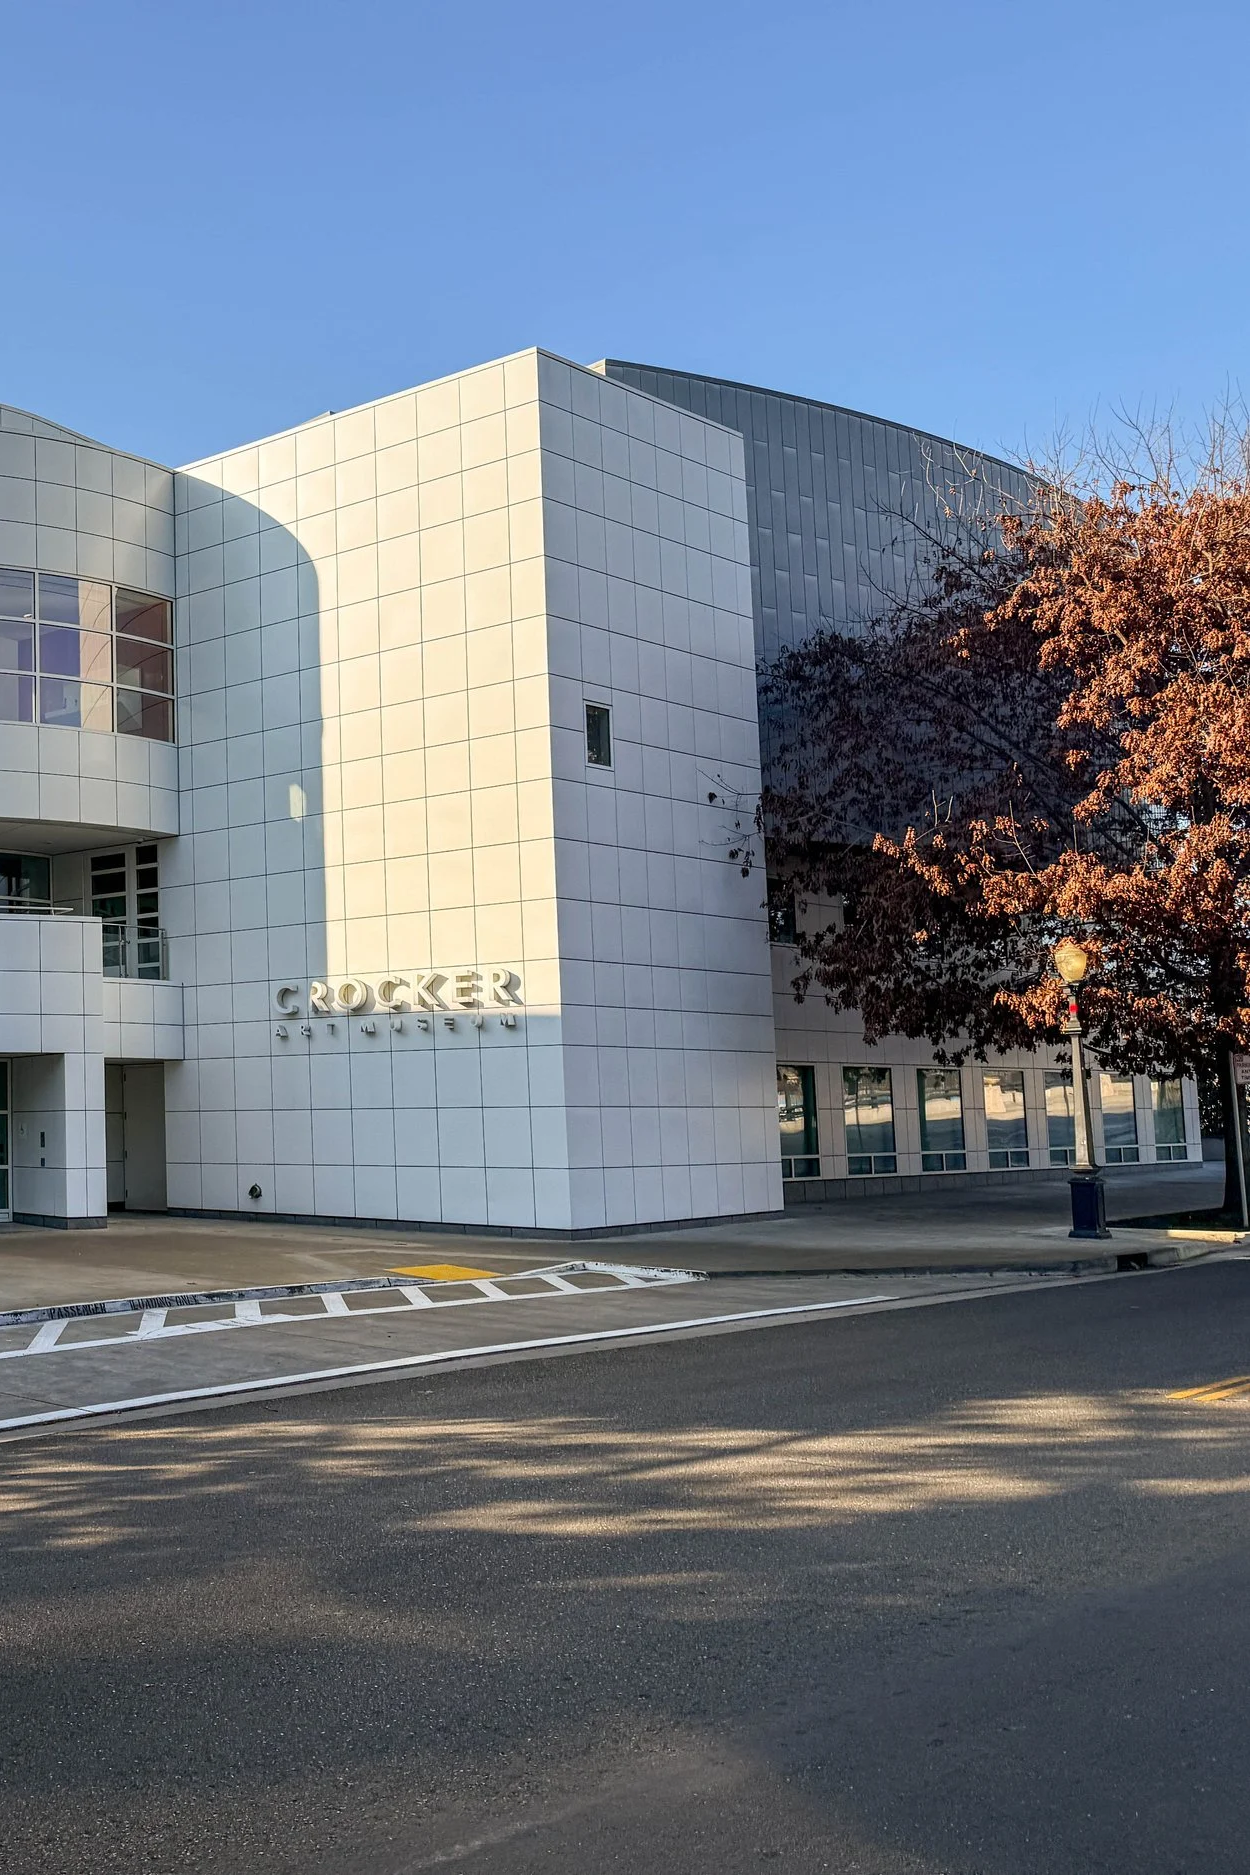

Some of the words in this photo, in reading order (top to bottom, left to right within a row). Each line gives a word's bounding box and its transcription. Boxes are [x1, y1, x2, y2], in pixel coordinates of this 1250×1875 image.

[275, 968, 516, 1015] CROCKER
[275, 1022, 335, 1040] ART
[360, 1012, 518, 1034] MUSEUM
[49, 1302, 107, 1320] PASSENGER
